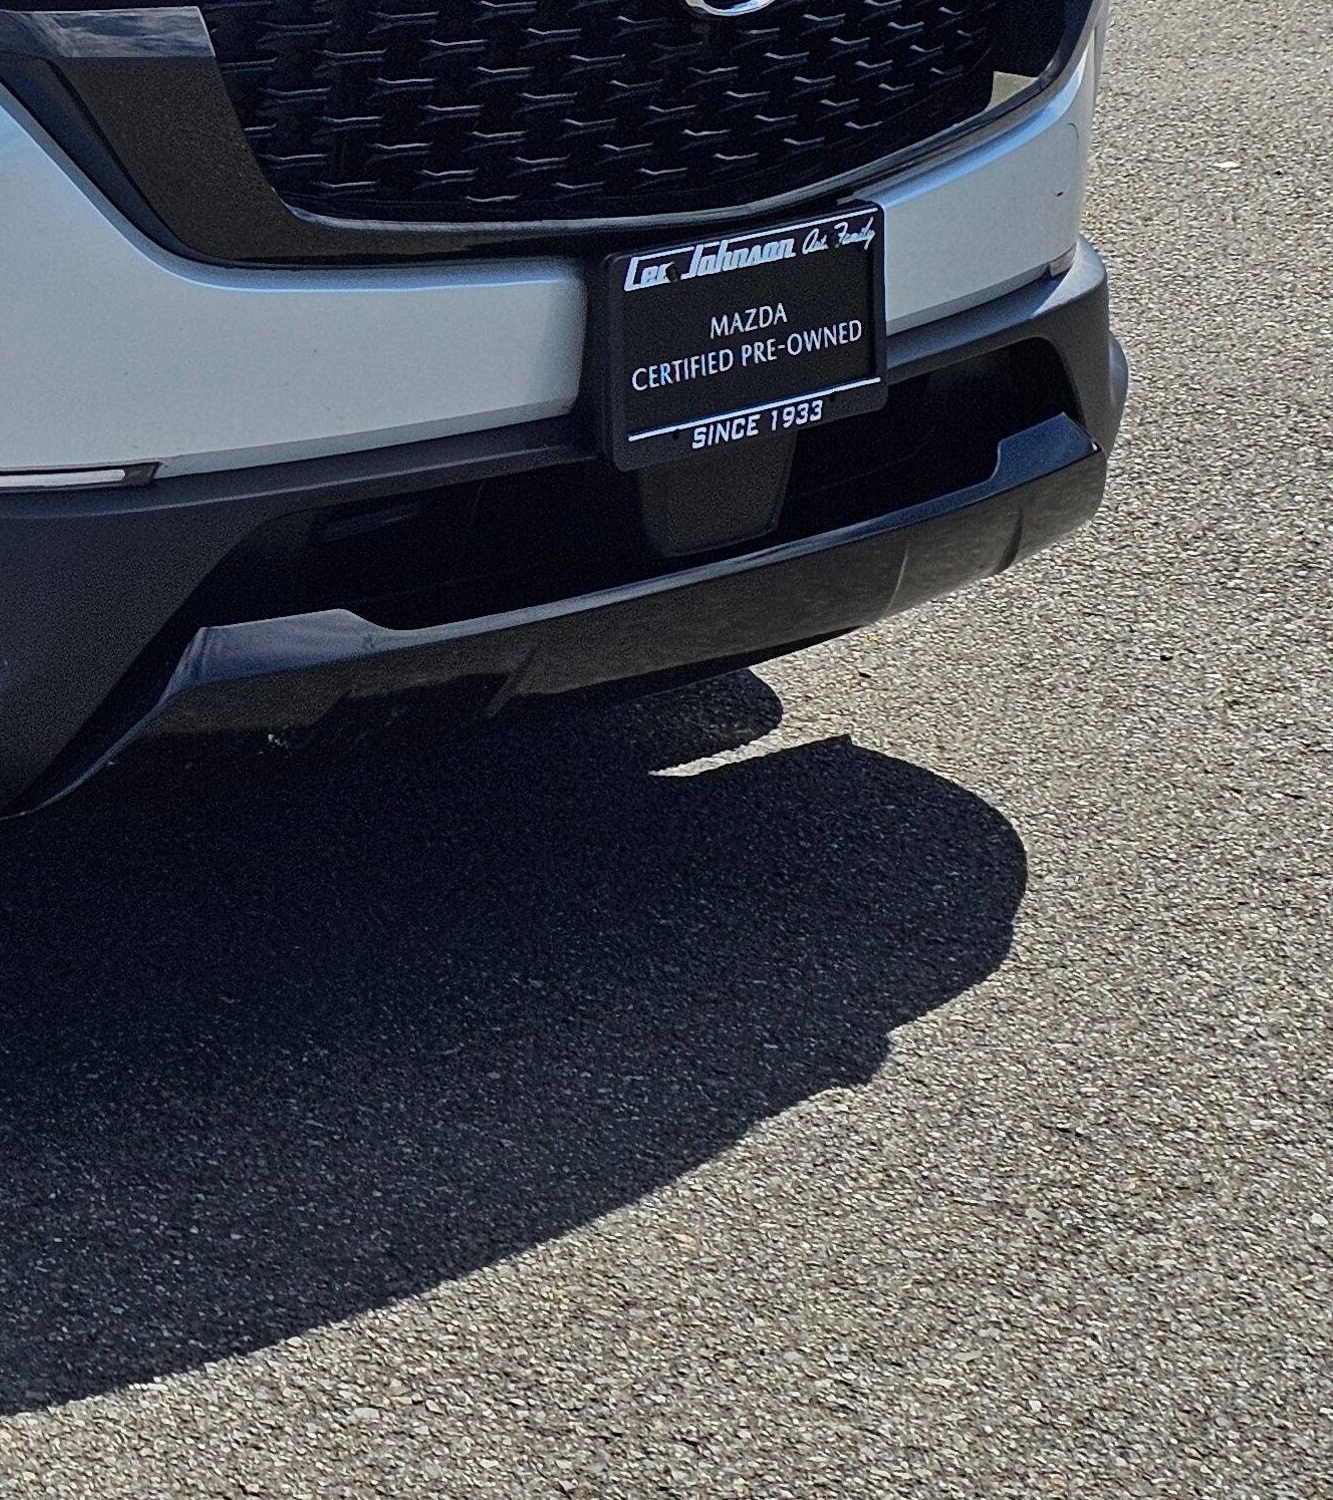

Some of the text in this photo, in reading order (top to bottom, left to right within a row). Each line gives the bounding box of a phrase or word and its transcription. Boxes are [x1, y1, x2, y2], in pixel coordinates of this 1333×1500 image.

[680, 238, 797, 280] Johnson
[709, 302, 788, 339] MAZDA
[631, 319, 863, 391] CERTIFIED PRE-OWNED
[691, 399, 824, 449] SINCE 1933
